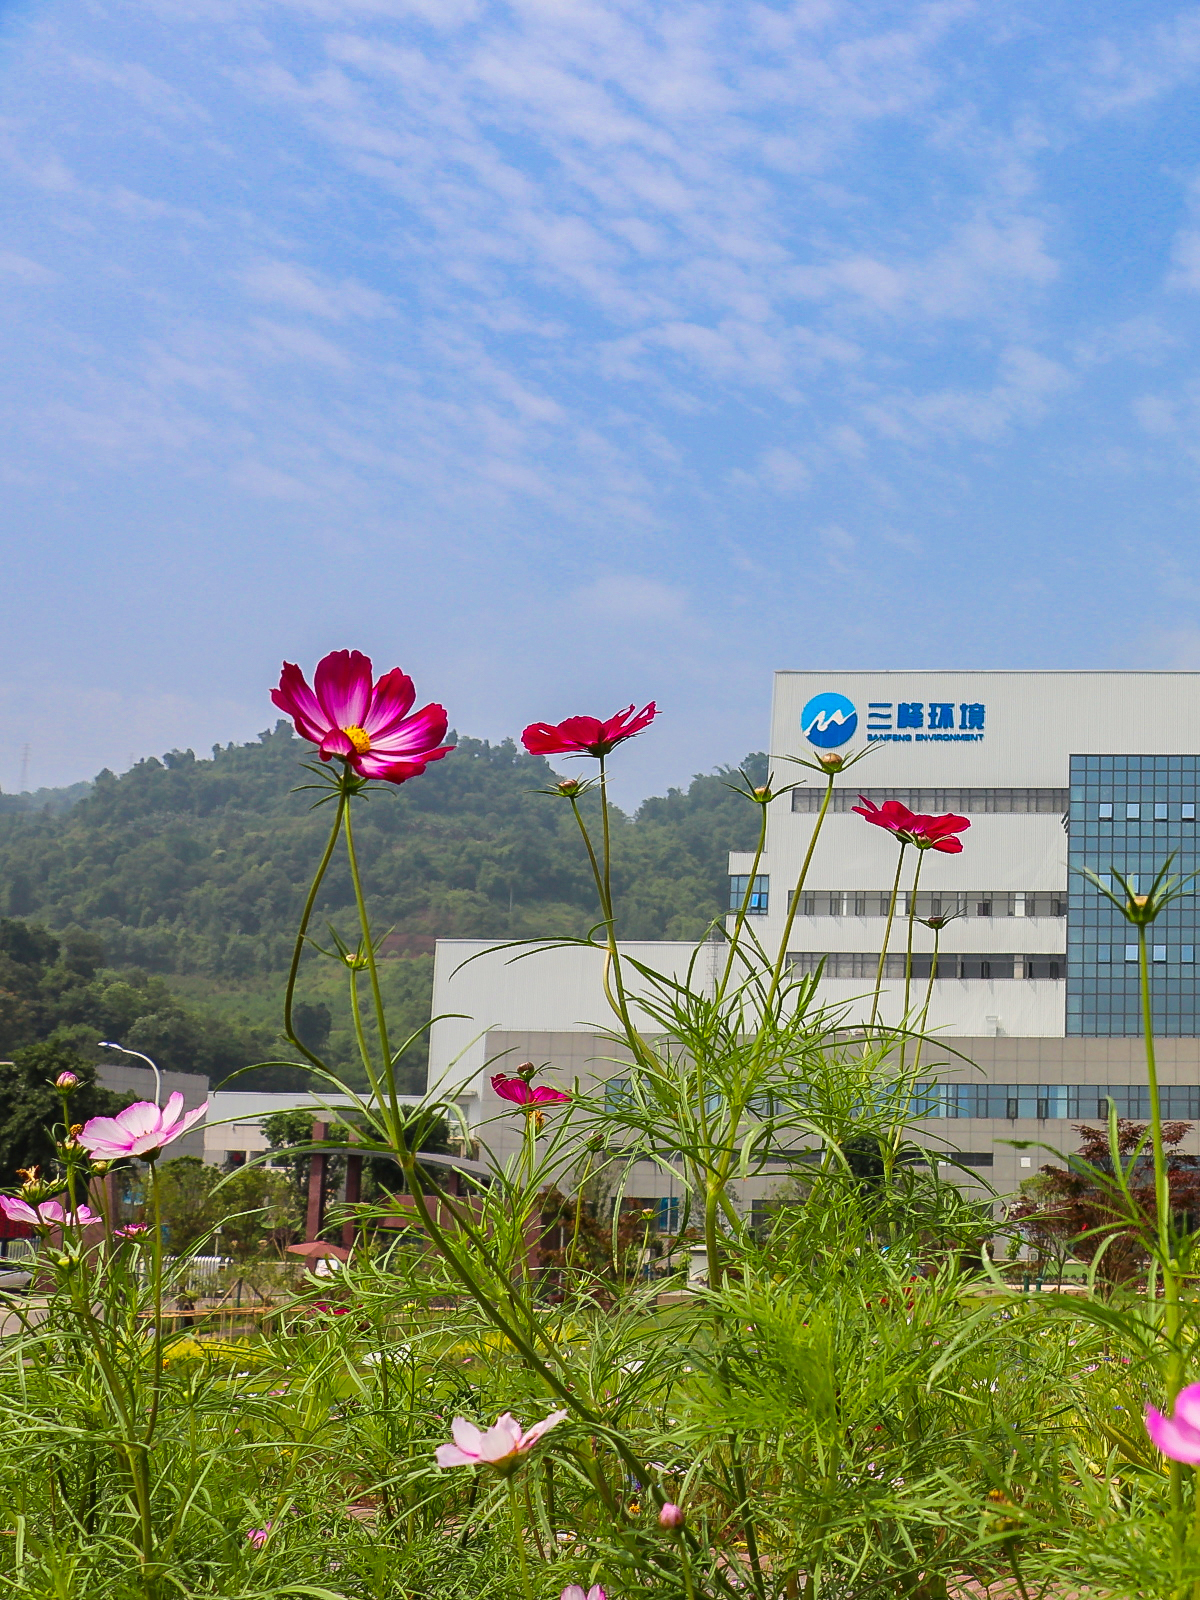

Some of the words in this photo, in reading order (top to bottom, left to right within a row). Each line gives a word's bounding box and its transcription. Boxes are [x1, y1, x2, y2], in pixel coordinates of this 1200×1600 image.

[866, 702, 986, 730] 三峰环境
[867, 733, 912, 742] SANFENG
[915, 733, 984, 742] ENVIRONMENT
